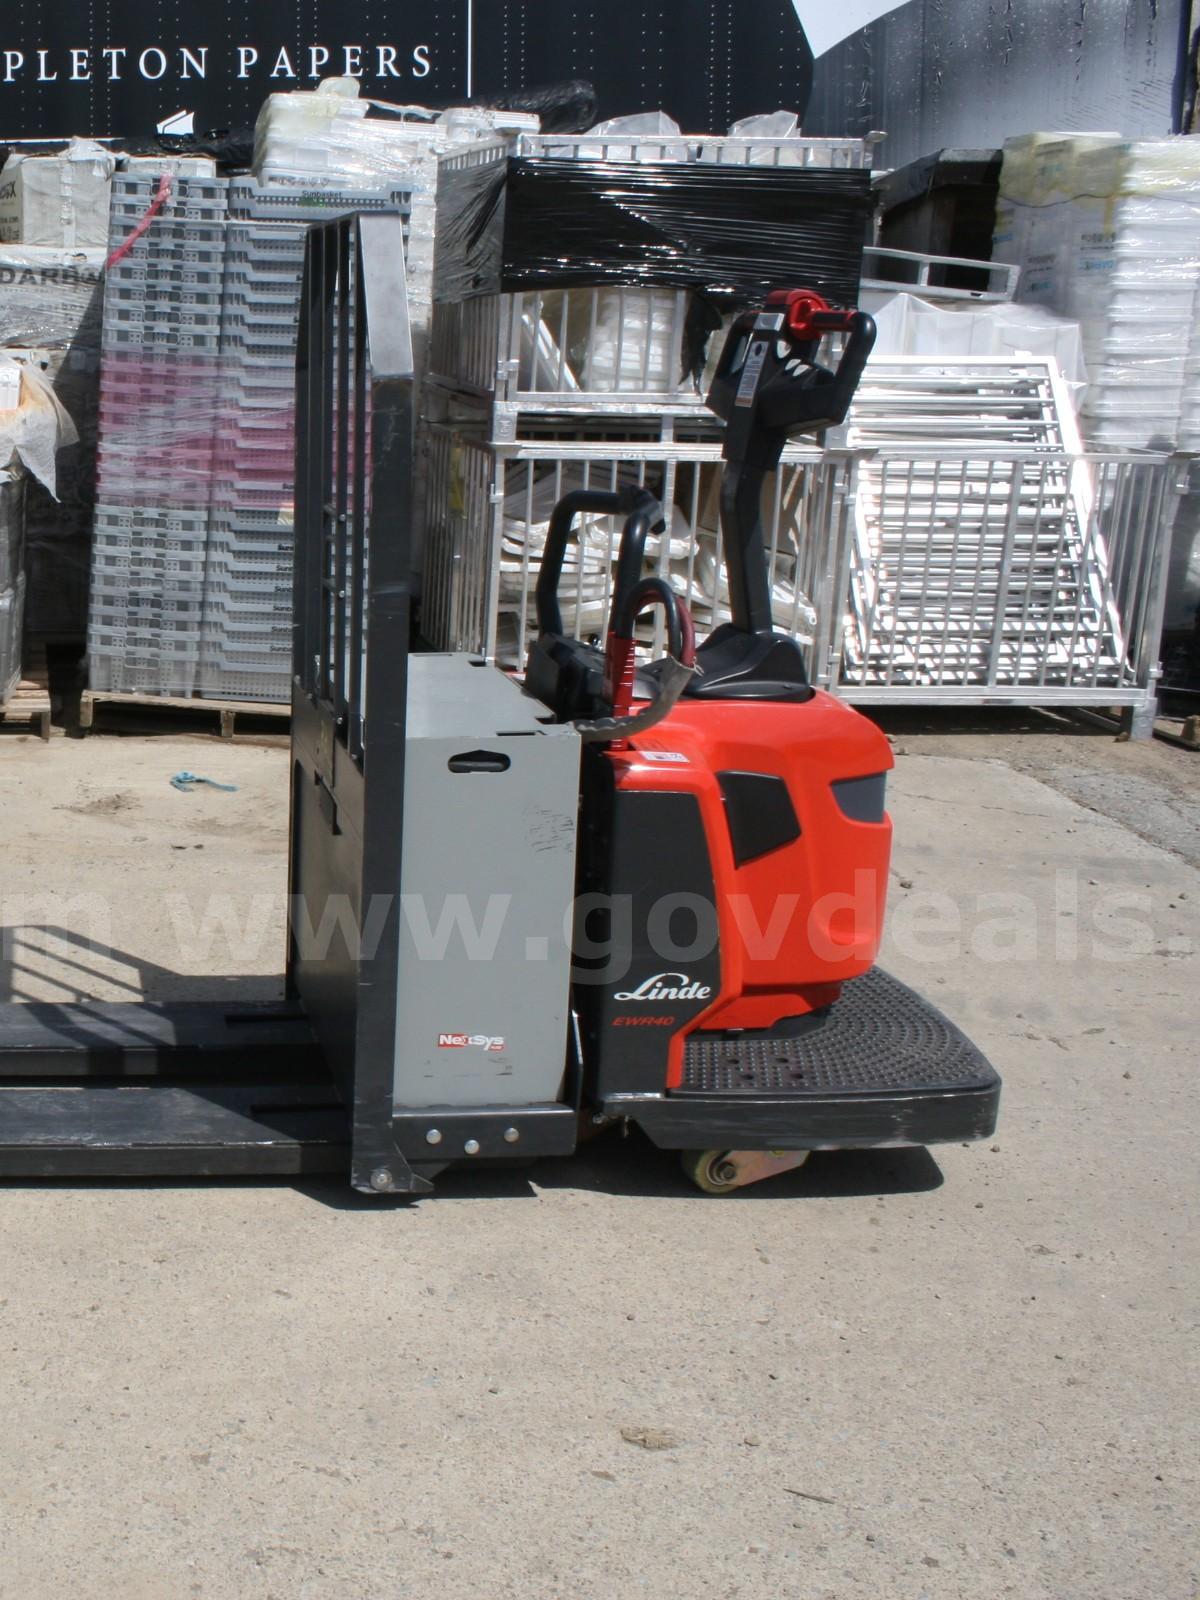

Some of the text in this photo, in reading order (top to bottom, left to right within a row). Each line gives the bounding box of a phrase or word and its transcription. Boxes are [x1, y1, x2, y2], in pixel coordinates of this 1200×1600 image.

[238, 45, 432, 80] PAPERS
[302, 190, 343, 199] Sunbasket
[613, 972, 711, 1000] Linde
